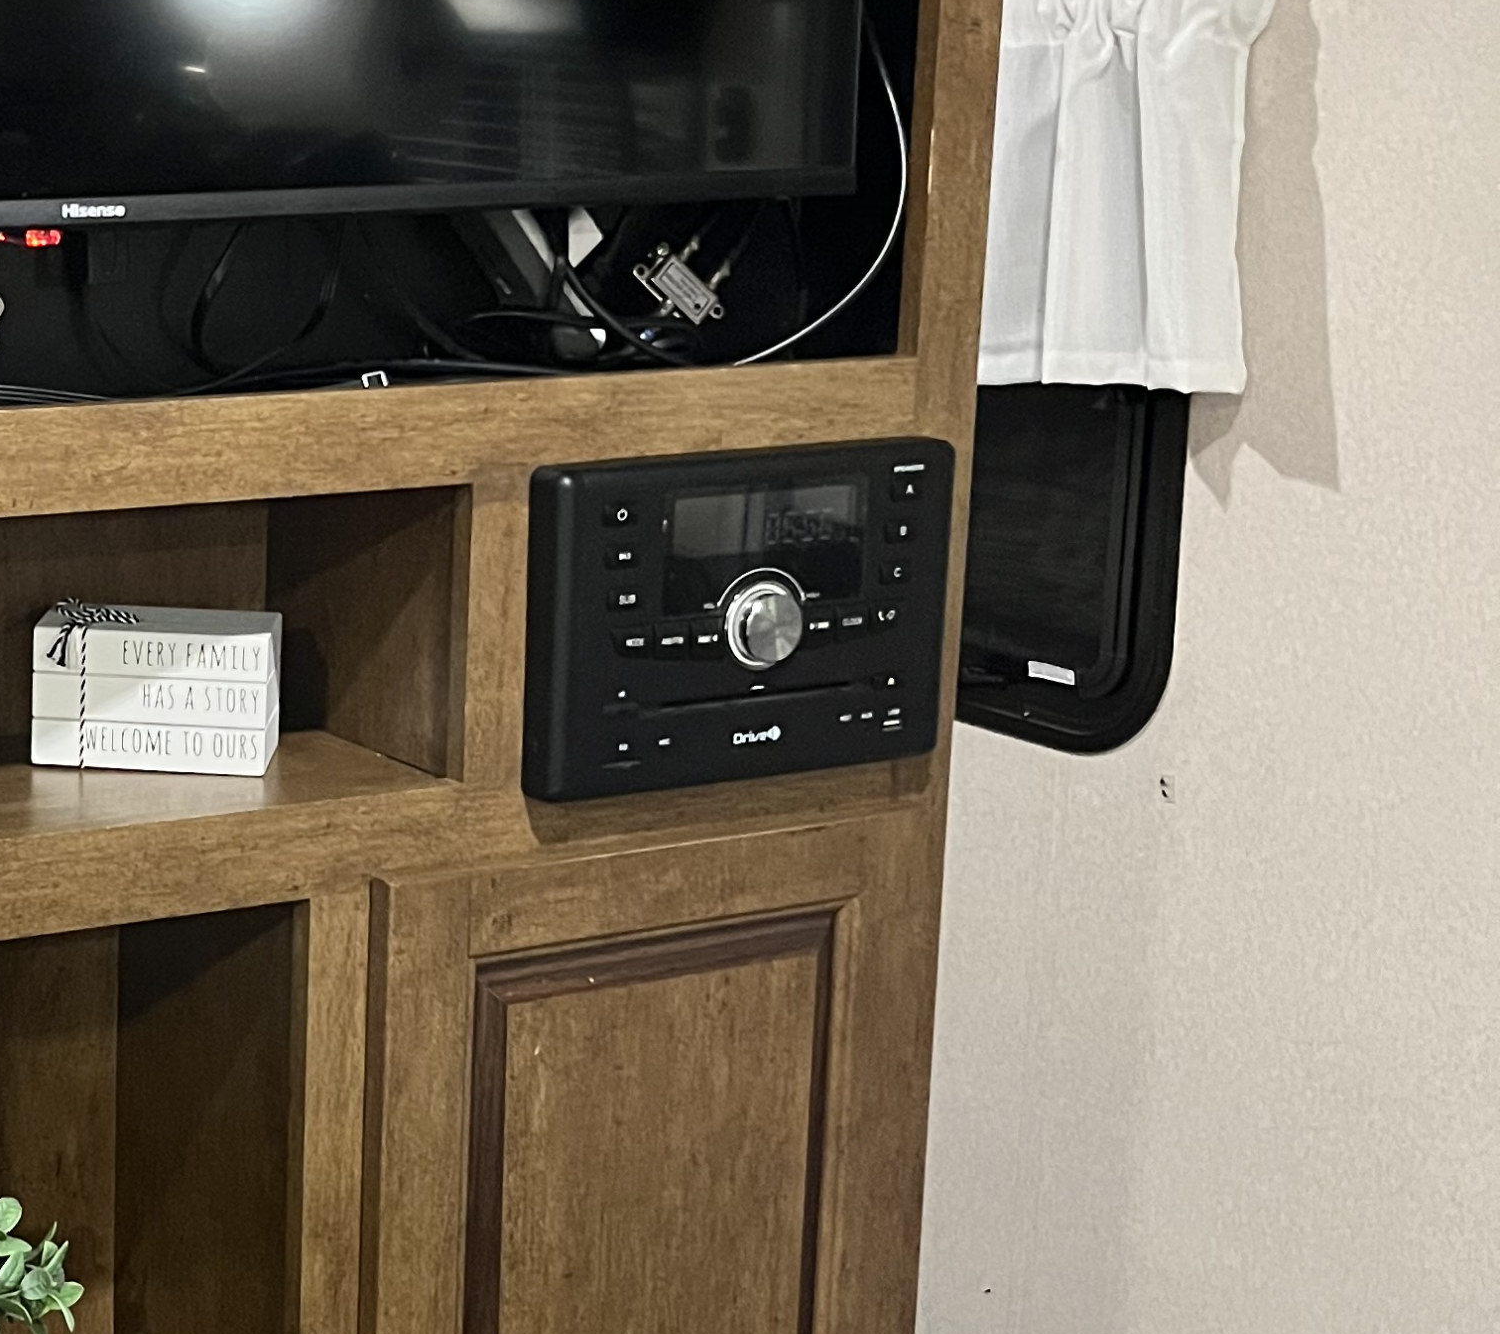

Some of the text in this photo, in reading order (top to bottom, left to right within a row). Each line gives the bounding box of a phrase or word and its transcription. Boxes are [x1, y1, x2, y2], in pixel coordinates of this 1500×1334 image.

[61, 203, 126, 218] Hisense
[122, 639, 261, 671] EVERY FAMILY
[142, 683, 260, 714] HAS A STORY
[85, 726, 258, 760] WELCOME TO OURS
